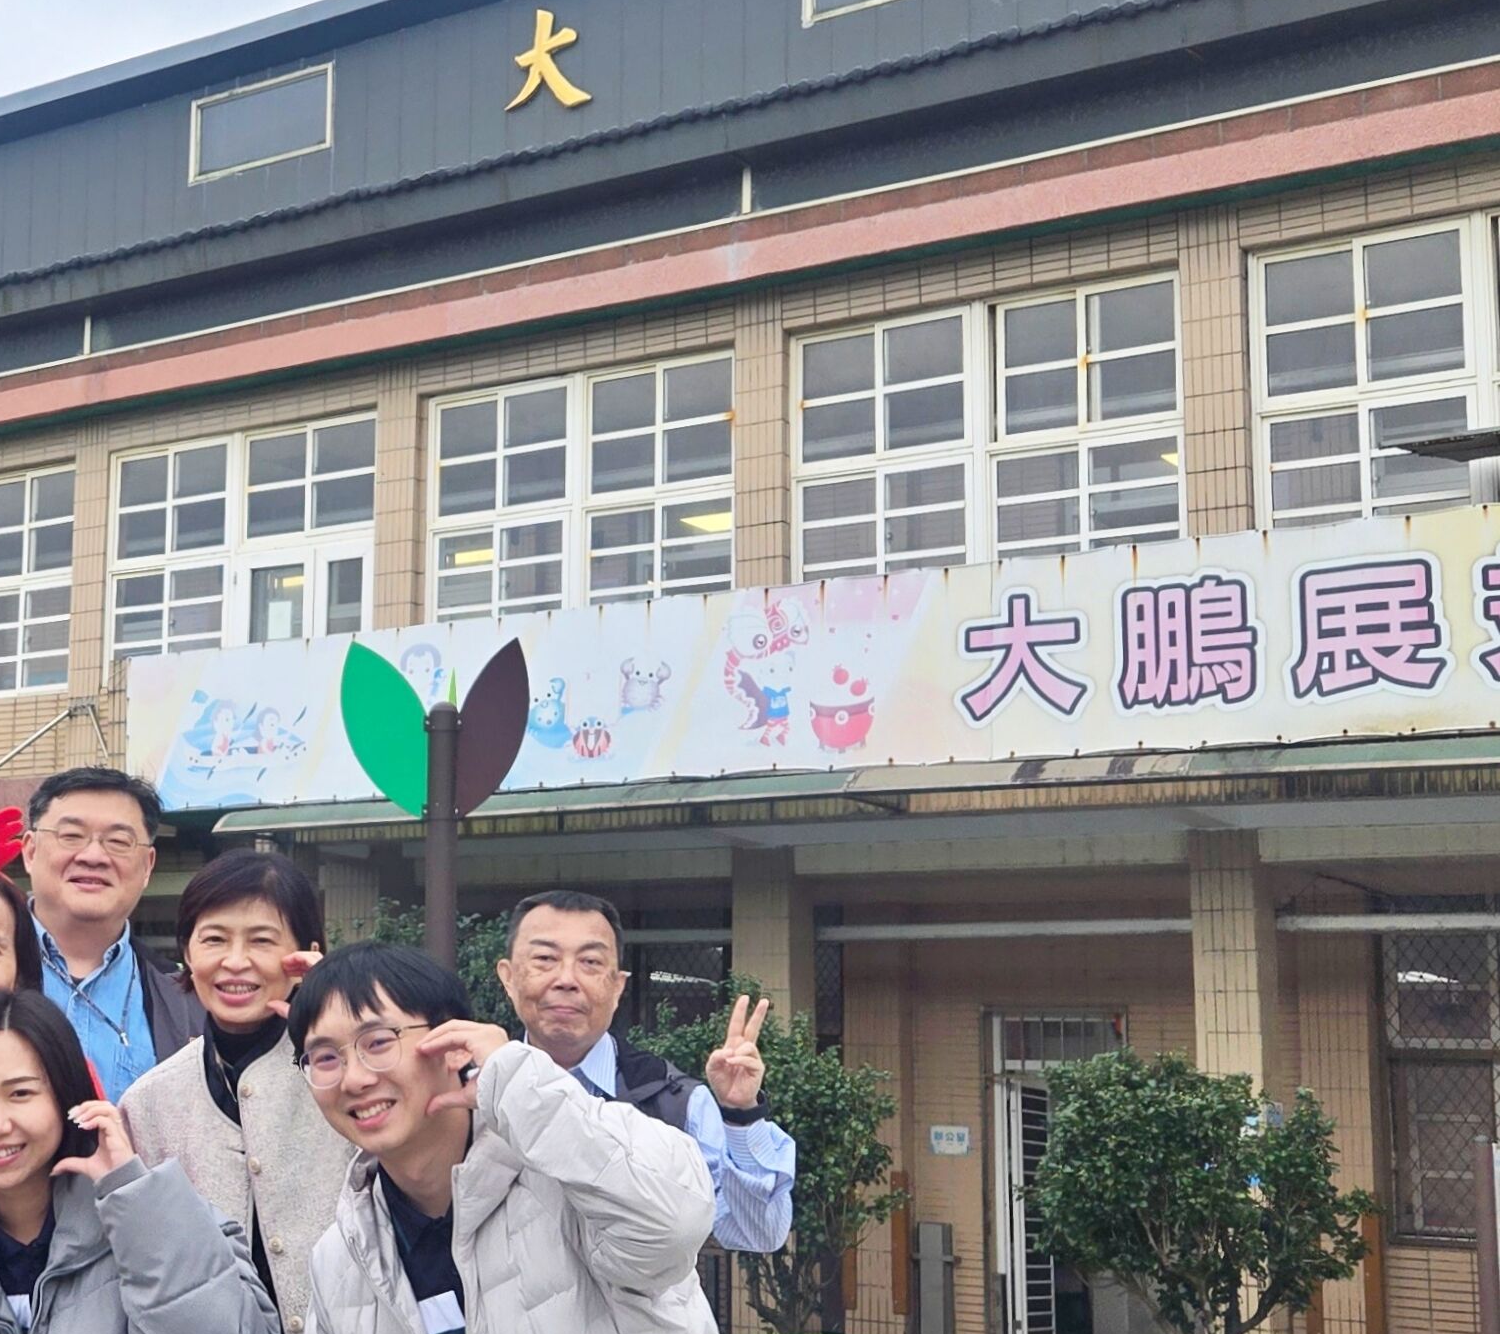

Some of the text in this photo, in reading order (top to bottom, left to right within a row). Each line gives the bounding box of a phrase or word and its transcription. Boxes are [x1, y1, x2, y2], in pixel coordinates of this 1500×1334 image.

[504, 8, 592, 111] 大
[960, 559, 1500, 722] 大鵬展
